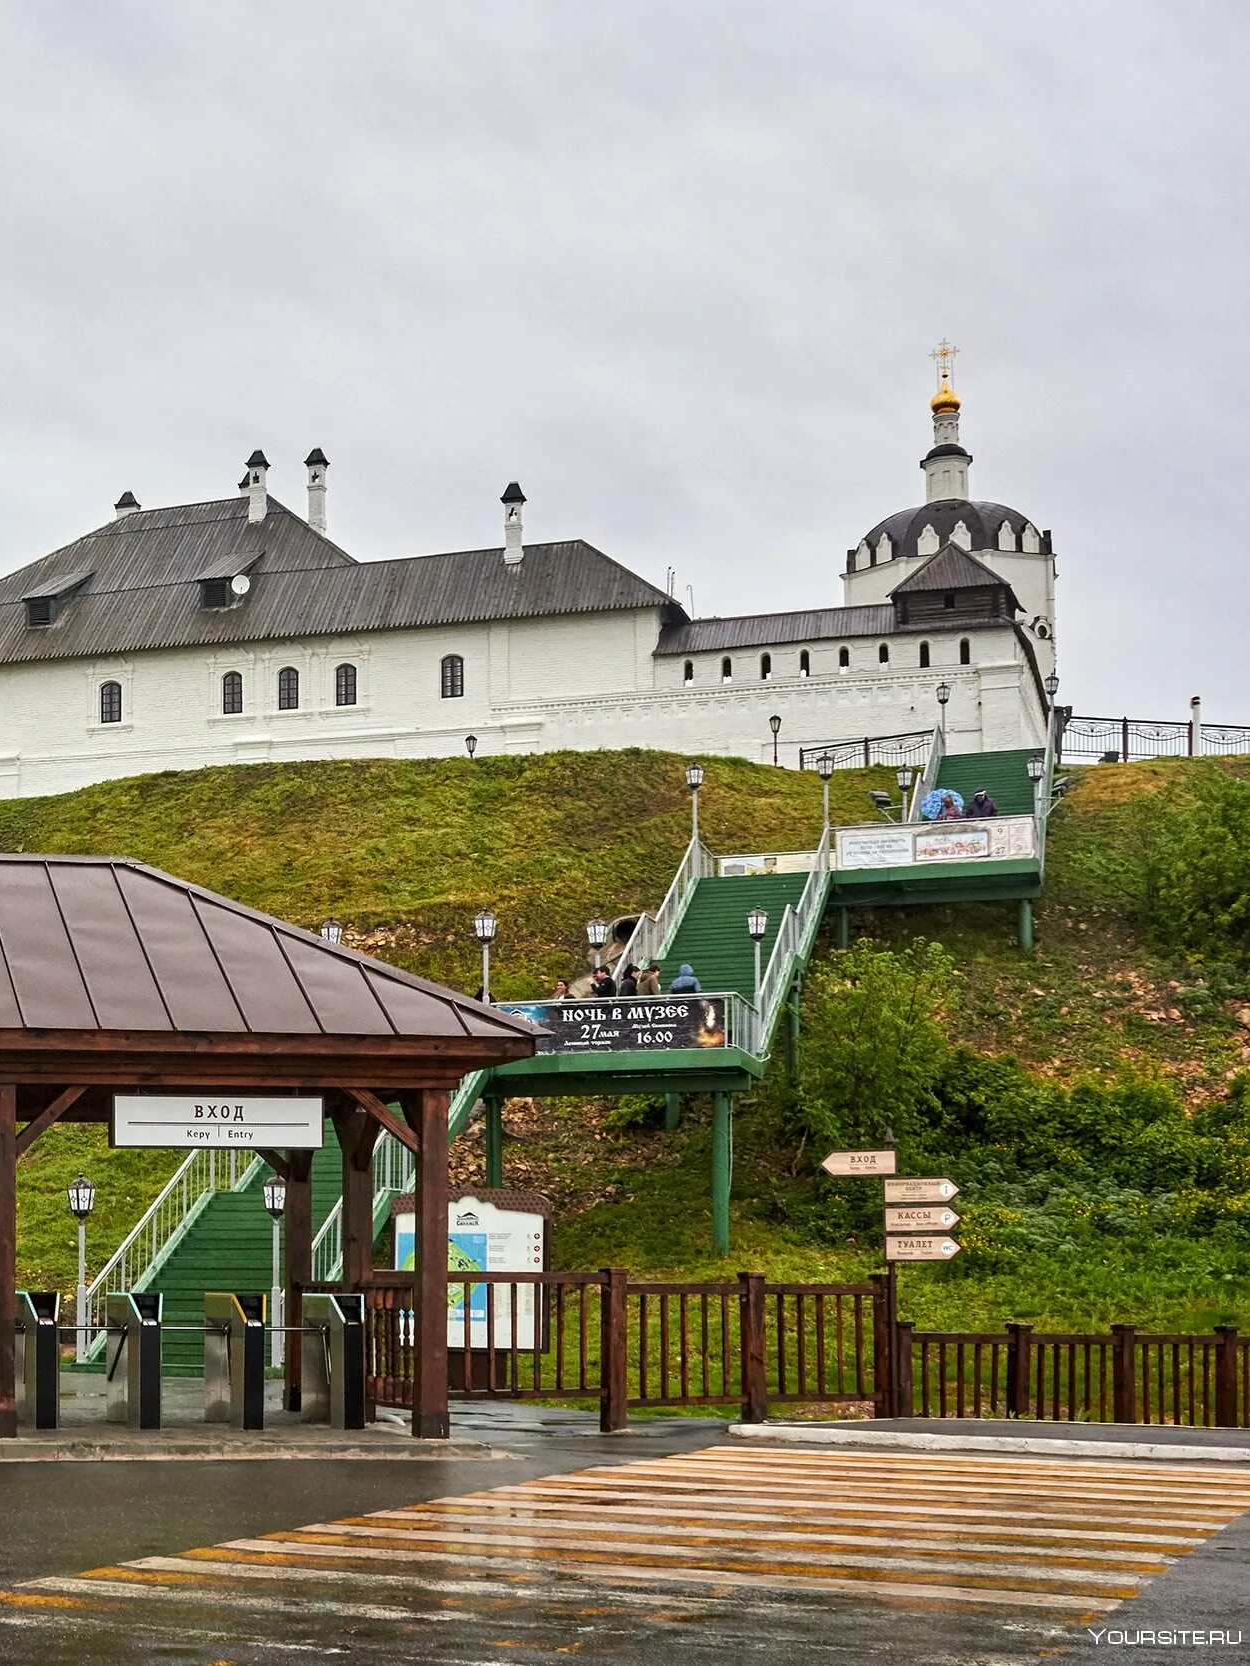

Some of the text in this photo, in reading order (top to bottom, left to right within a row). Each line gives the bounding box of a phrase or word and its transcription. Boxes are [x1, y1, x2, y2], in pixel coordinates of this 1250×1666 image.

[562, 1008, 607, 1022] НОЧЬ
[627, 1004, 689, 1023] МУЗЕЕ
[580, 1024, 601, 1039] 27
[636, 1031, 674, 1044] 16.00
[194, 1105, 244, 1121] ВХОД
[228, 1130, 253, 1140] Entry
[850, 1155, 876, 1164] ВХОД
[897, 1211, 931, 1219] КАССЫ
[897, 1240, 933, 1248] ТУАЛЕТ
